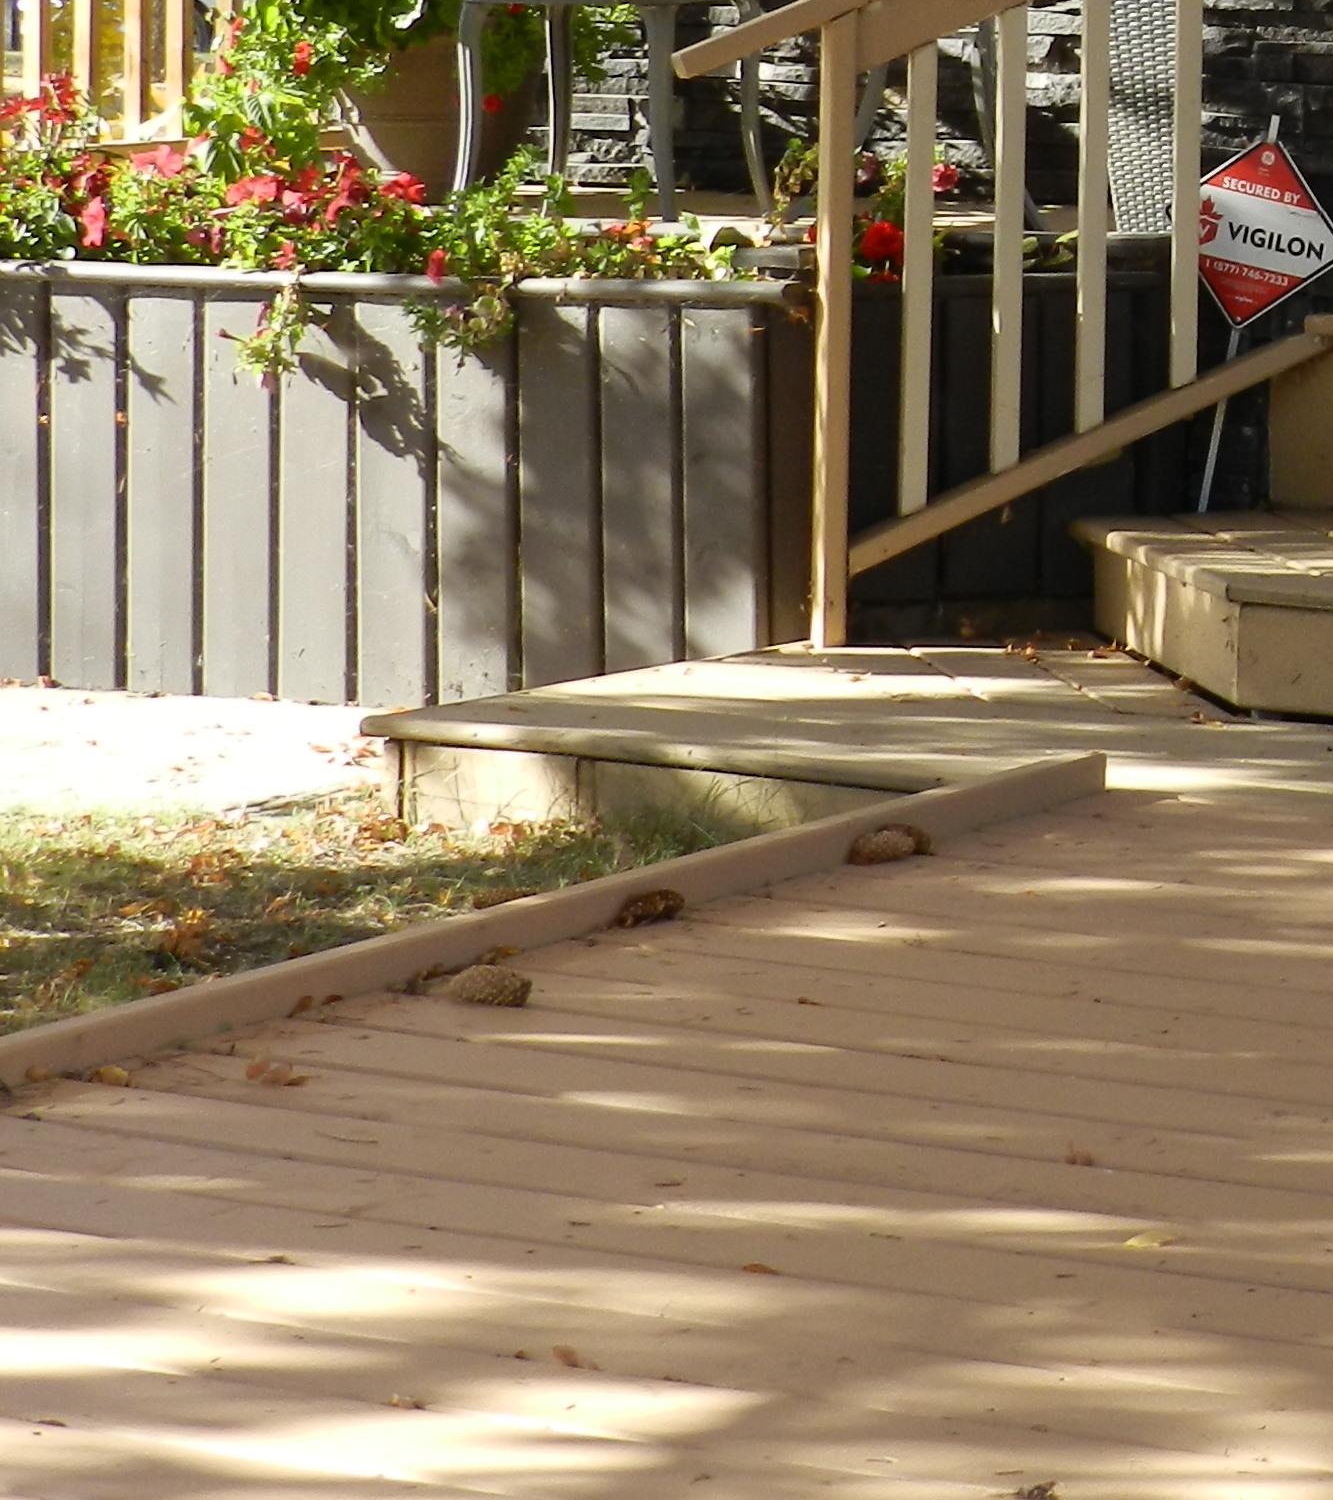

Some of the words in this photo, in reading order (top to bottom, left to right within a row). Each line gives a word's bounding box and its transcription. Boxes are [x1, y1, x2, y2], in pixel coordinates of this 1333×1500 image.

[1222, 176, 1281, 200] SECURED
[1283, 191, 1302, 205] BY
[1228, 221, 1325, 262] VIGILON
[1241, 267, 1289, 286] 746-7233
